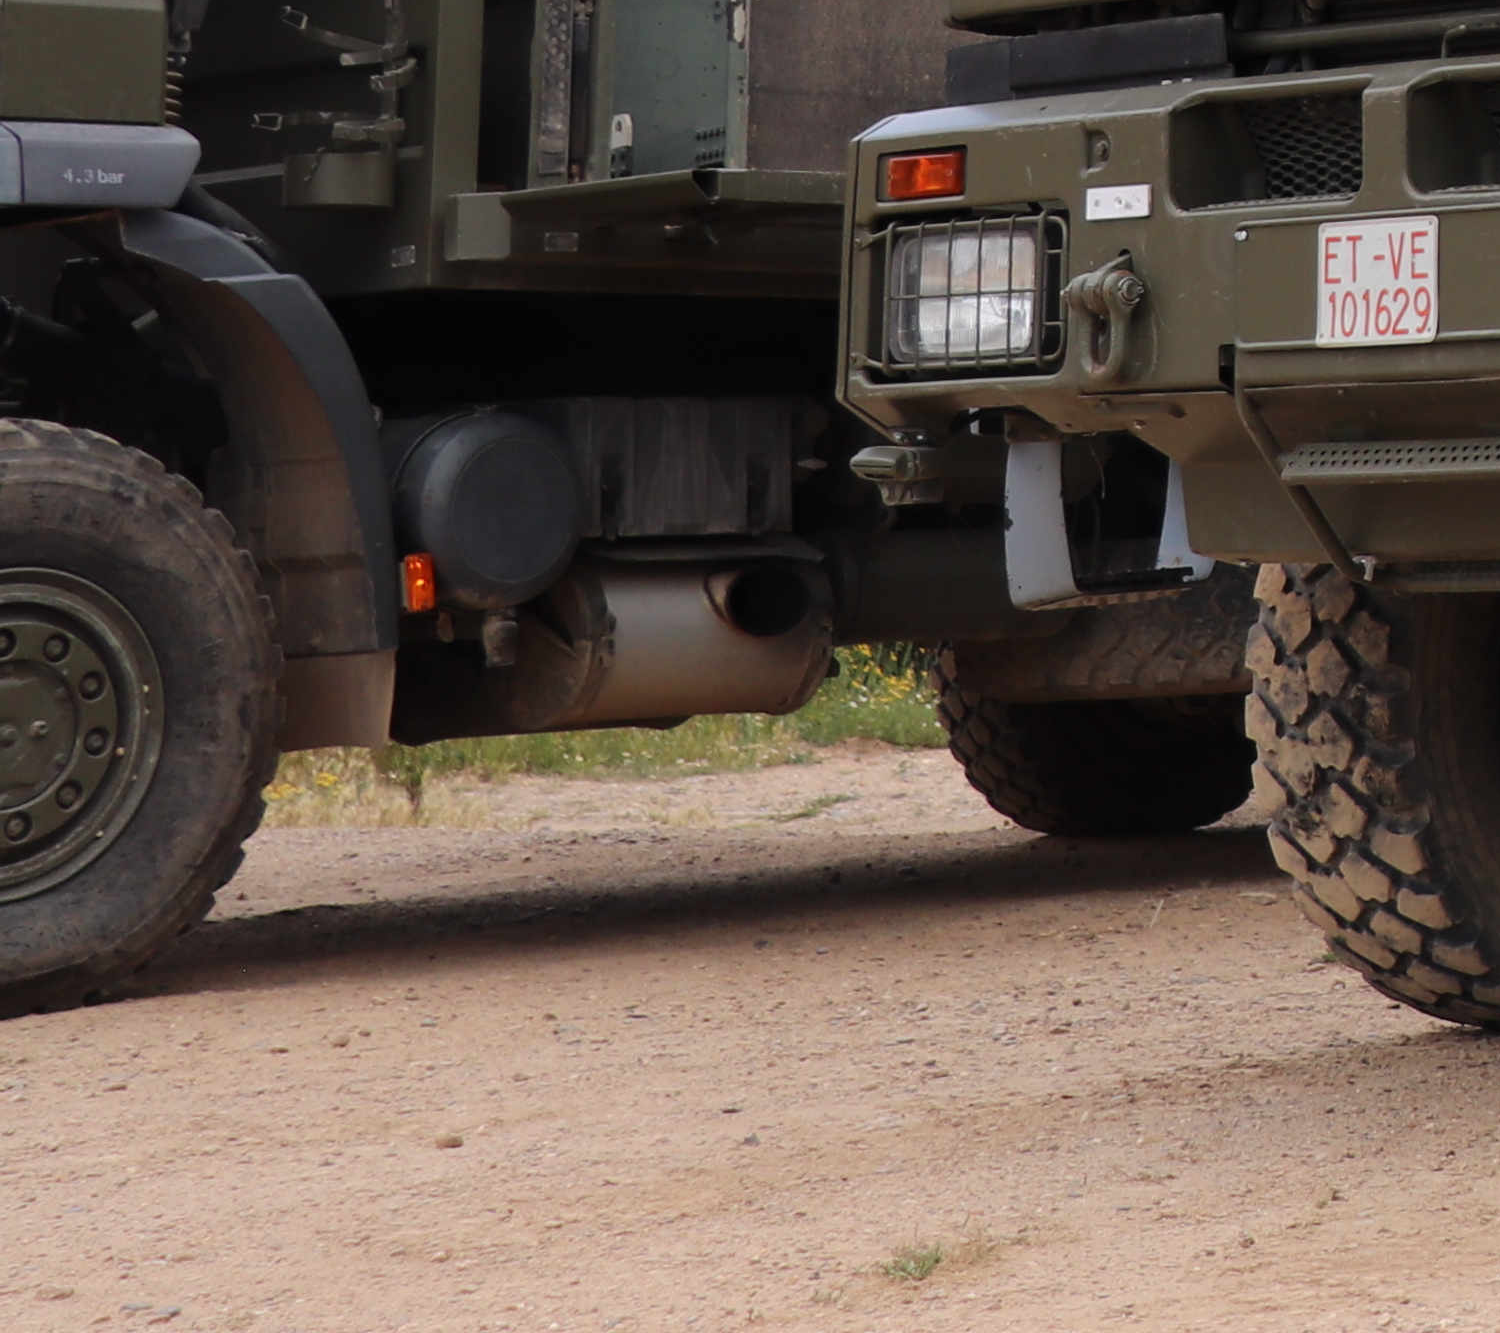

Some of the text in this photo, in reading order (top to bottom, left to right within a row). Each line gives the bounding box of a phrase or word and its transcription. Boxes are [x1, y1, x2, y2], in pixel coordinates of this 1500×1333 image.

[63, 168, 125, 184] 4.3 bar
[1328, 286, 1431, 338] 101629
